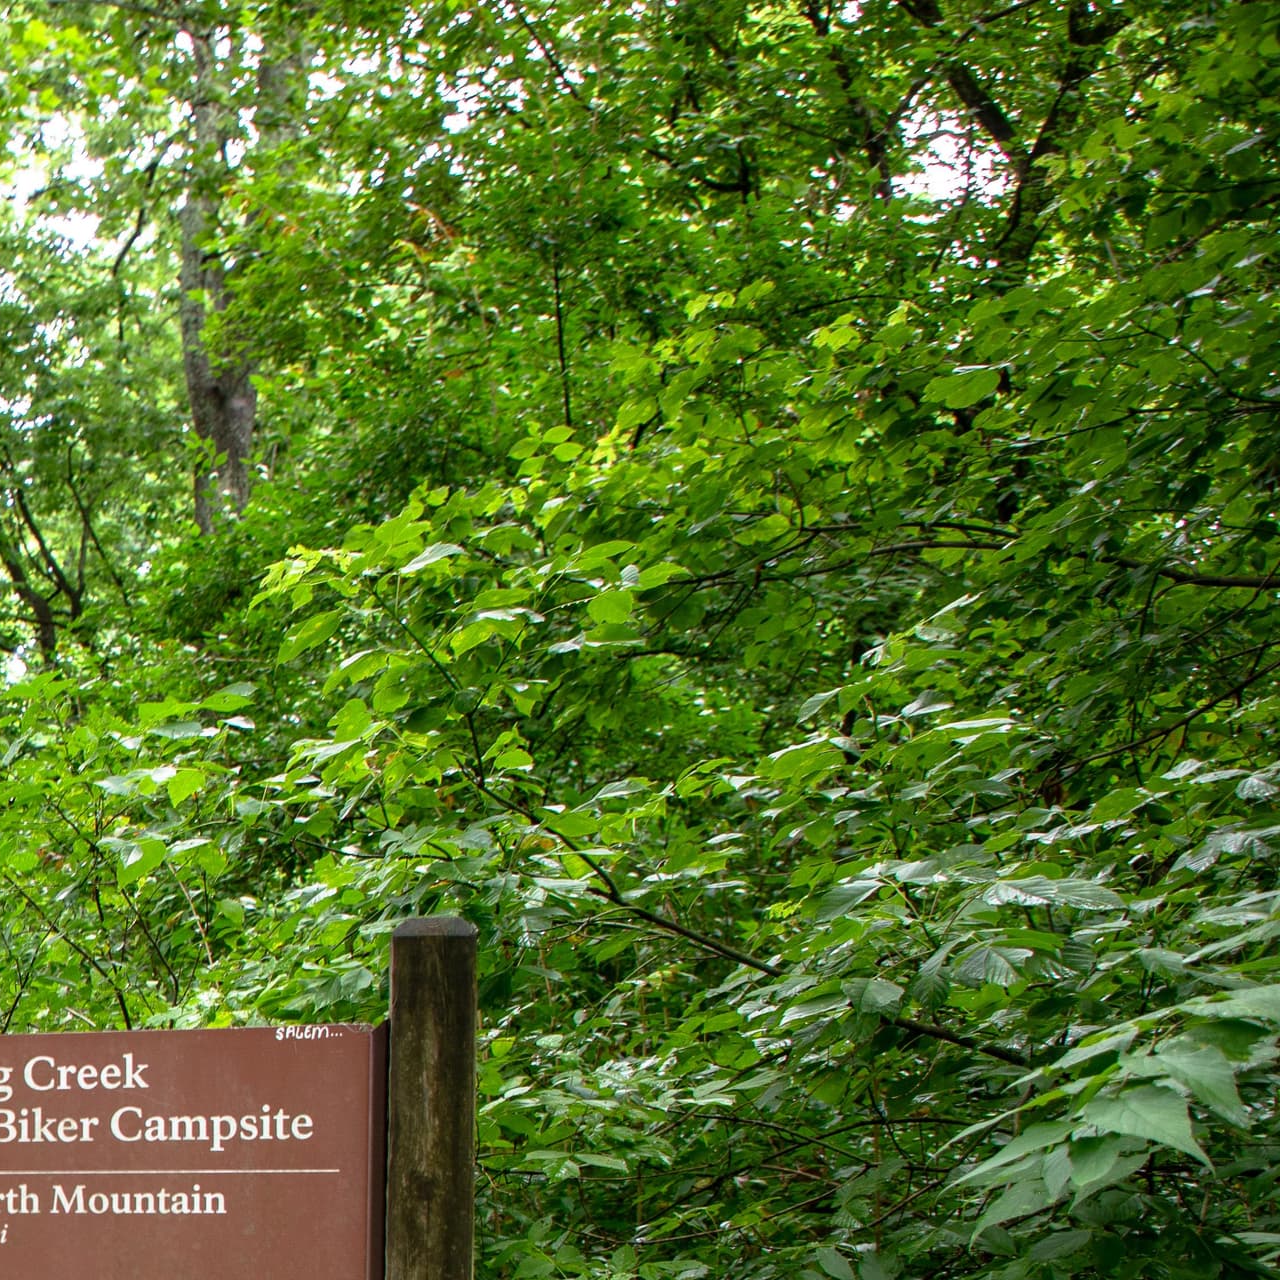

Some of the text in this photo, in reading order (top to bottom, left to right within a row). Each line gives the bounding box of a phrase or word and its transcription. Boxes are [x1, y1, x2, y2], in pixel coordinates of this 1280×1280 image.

[22, 1053, 150, 1092] Creek
[109, 1103, 314, 1152] Campsite
[49, 1183, 228, 1215] Mountain
